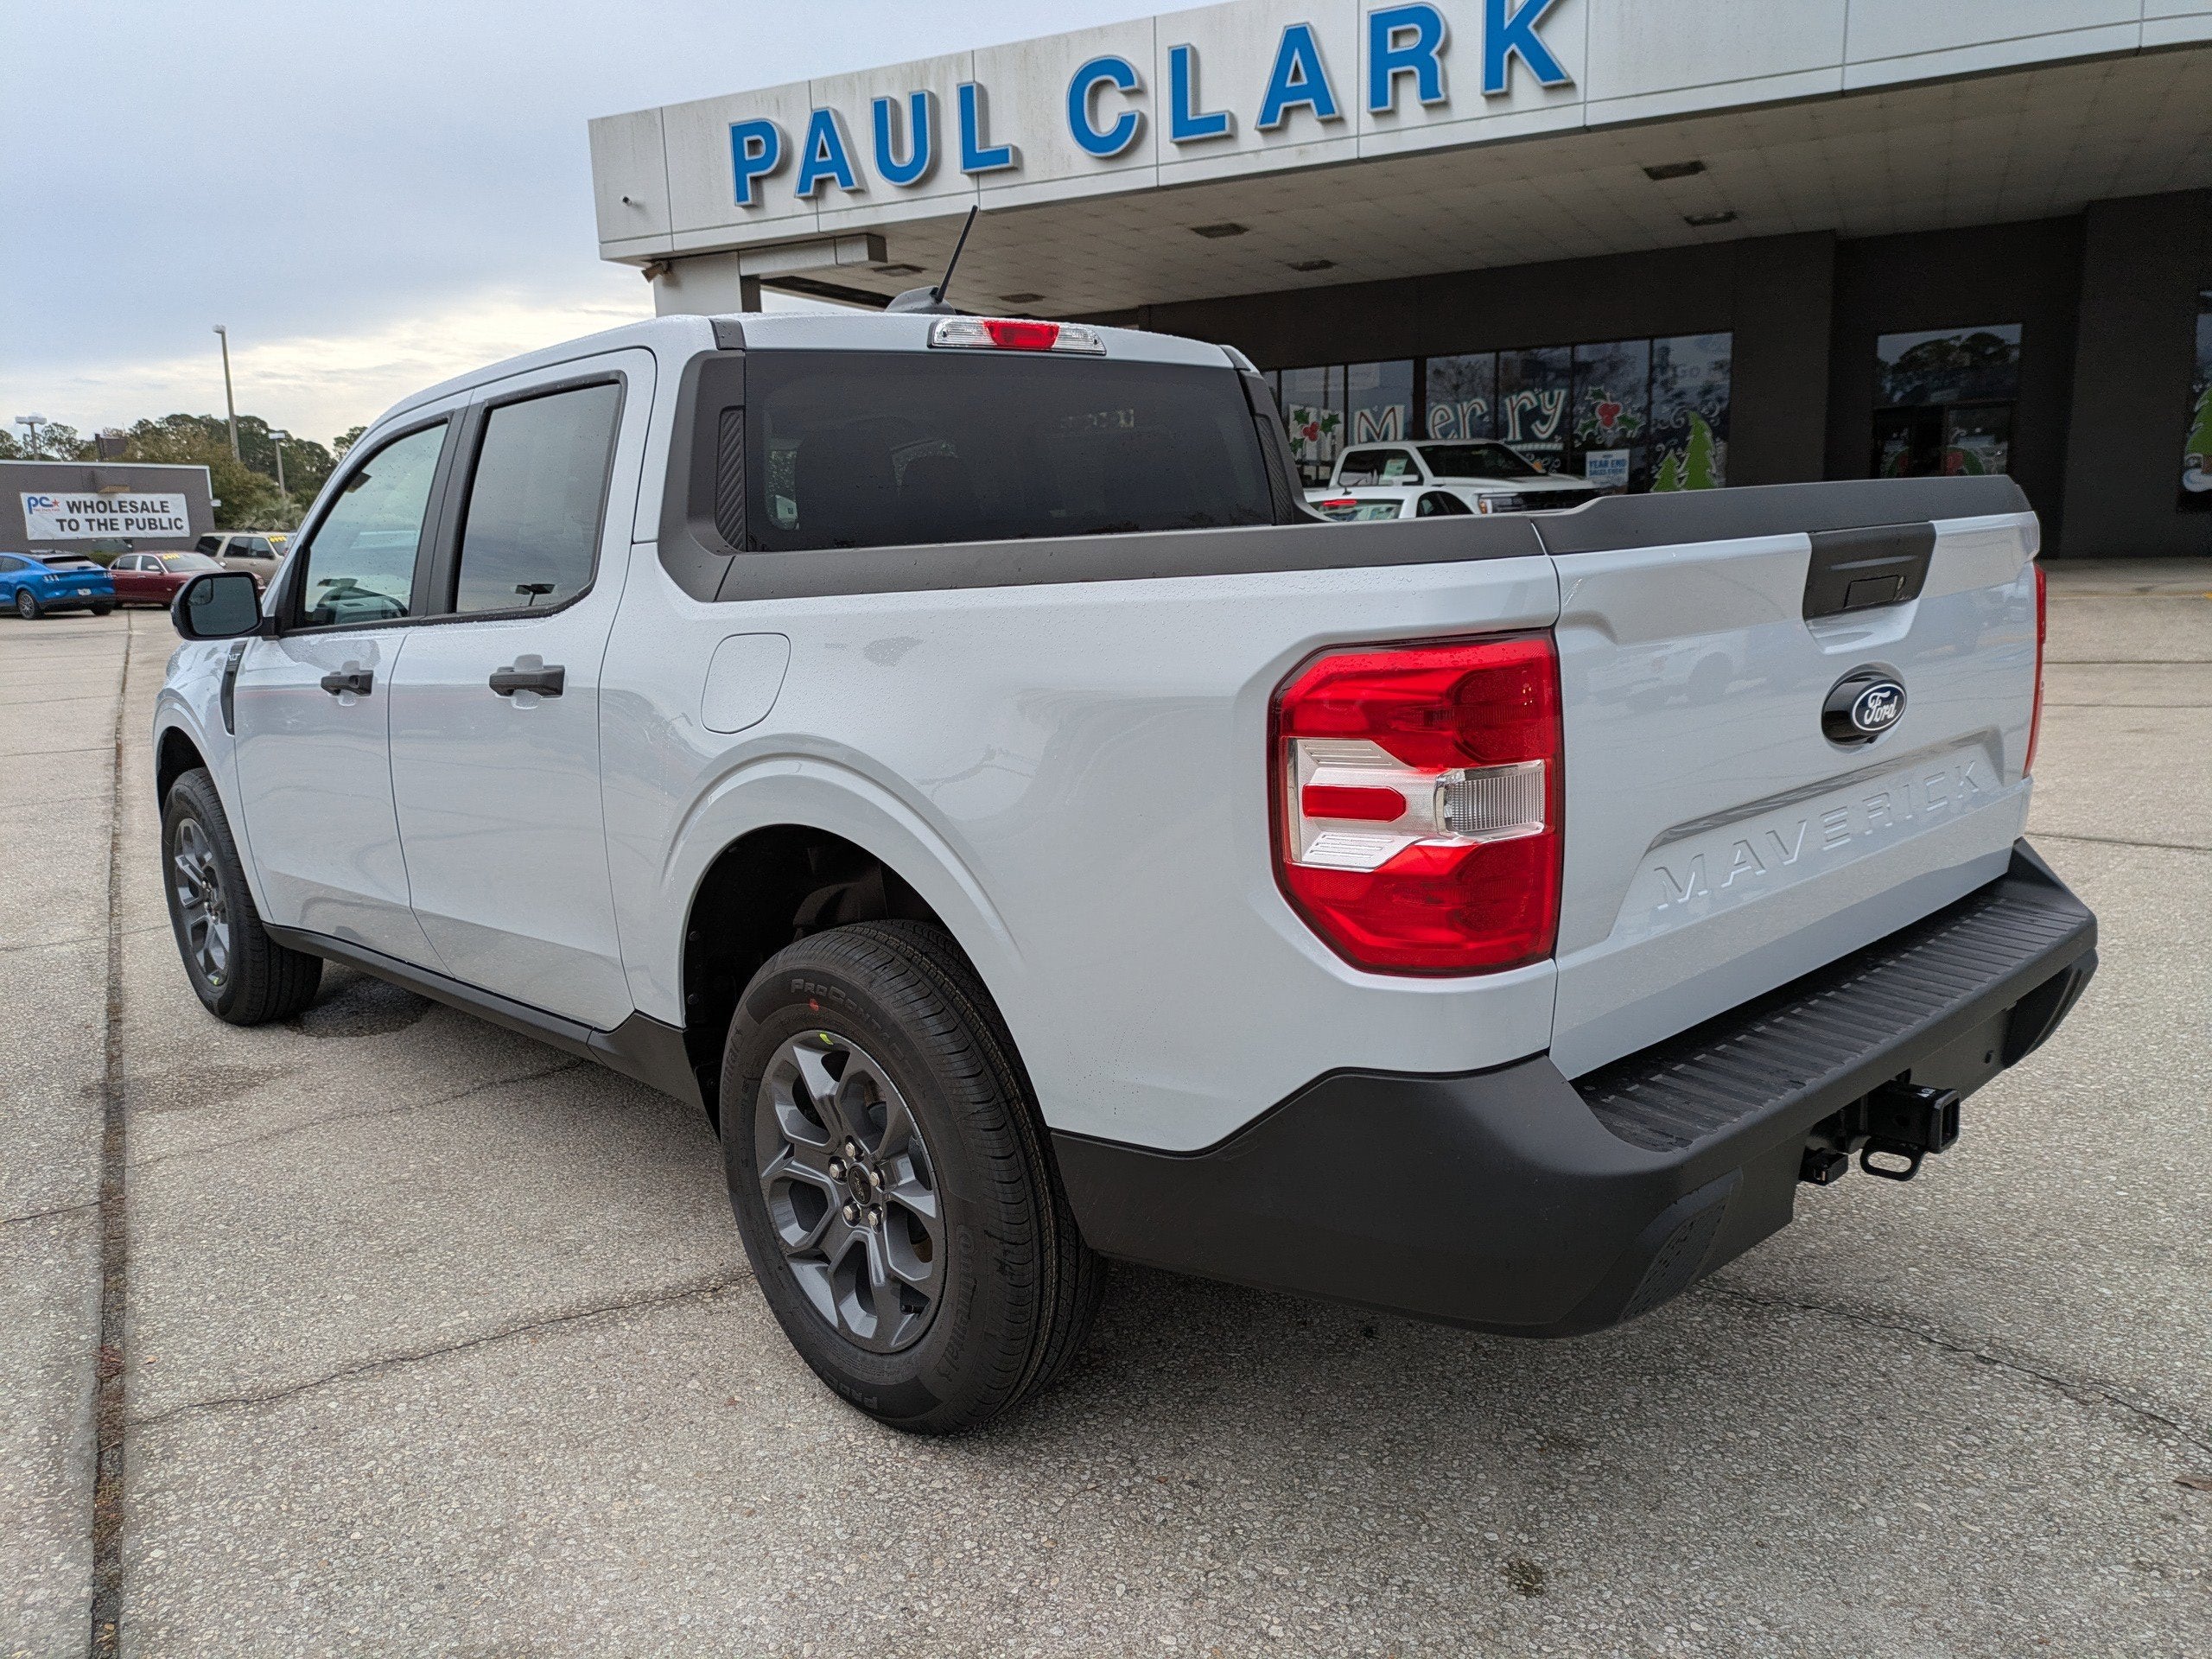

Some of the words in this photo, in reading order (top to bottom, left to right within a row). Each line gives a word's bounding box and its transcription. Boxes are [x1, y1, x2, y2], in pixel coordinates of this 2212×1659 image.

[728, 82, 1018, 207] PAUL
[1065, 0, 1573, 158] CLARK
[1354, 389, 1567, 442] Merry
[55, 518, 80, 531] TO
[86, 518, 120, 531] THE
[125, 518, 184, 531] PUBLIC
[66, 500, 170, 514] WHOLESALE
[1864, 690, 1898, 724] Ford
[1653, 759, 1980, 912] MAVERICK
